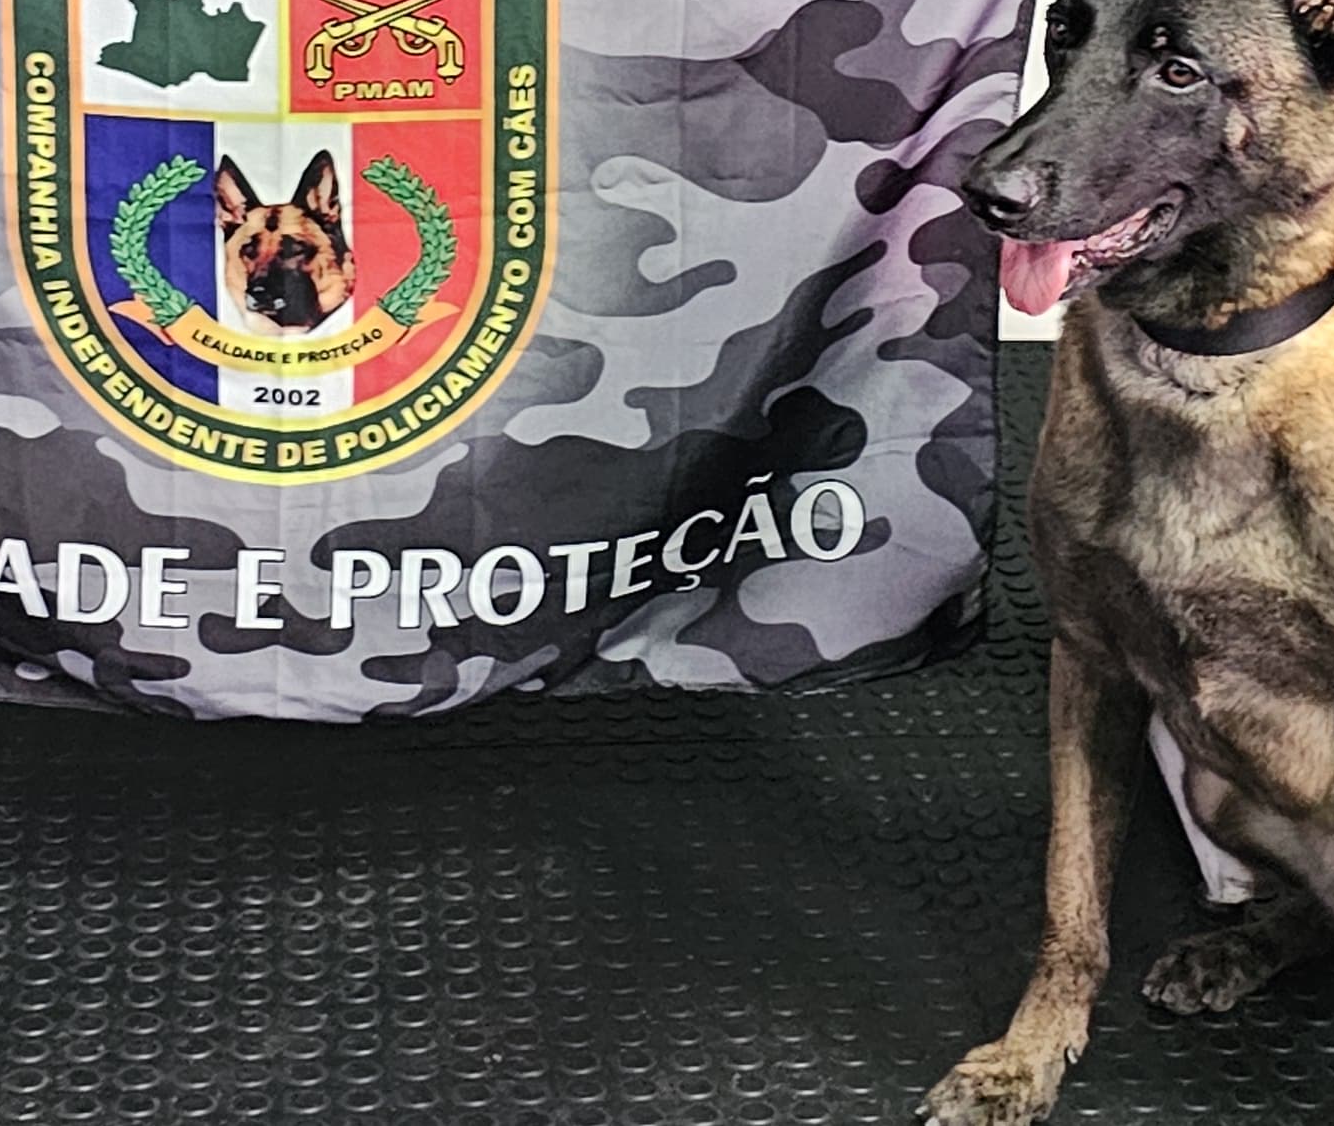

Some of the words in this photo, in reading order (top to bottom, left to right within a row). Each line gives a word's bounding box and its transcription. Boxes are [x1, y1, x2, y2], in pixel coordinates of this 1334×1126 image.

[333, 80, 435, 102] PMAM
[507, 63, 538, 161] CÃES
[23, 51, 64, 271] COMPANHIA
[508, 167, 537, 248] COM
[43, 278, 267, 466] INDEPENDENTE
[191, 328, 277, 363] LEALDADE
[281, 352, 292, 364] E
[297, 327, 384, 363] PROTEÇÃO
[336, 258, 532, 461] POLICIAMENTO
[253, 387, 321, 406] 2002
[276, 438, 328, 469] DE
[233, 545, 287, 631] E
[328, 473, 866, 631] PROTEÇÃO
